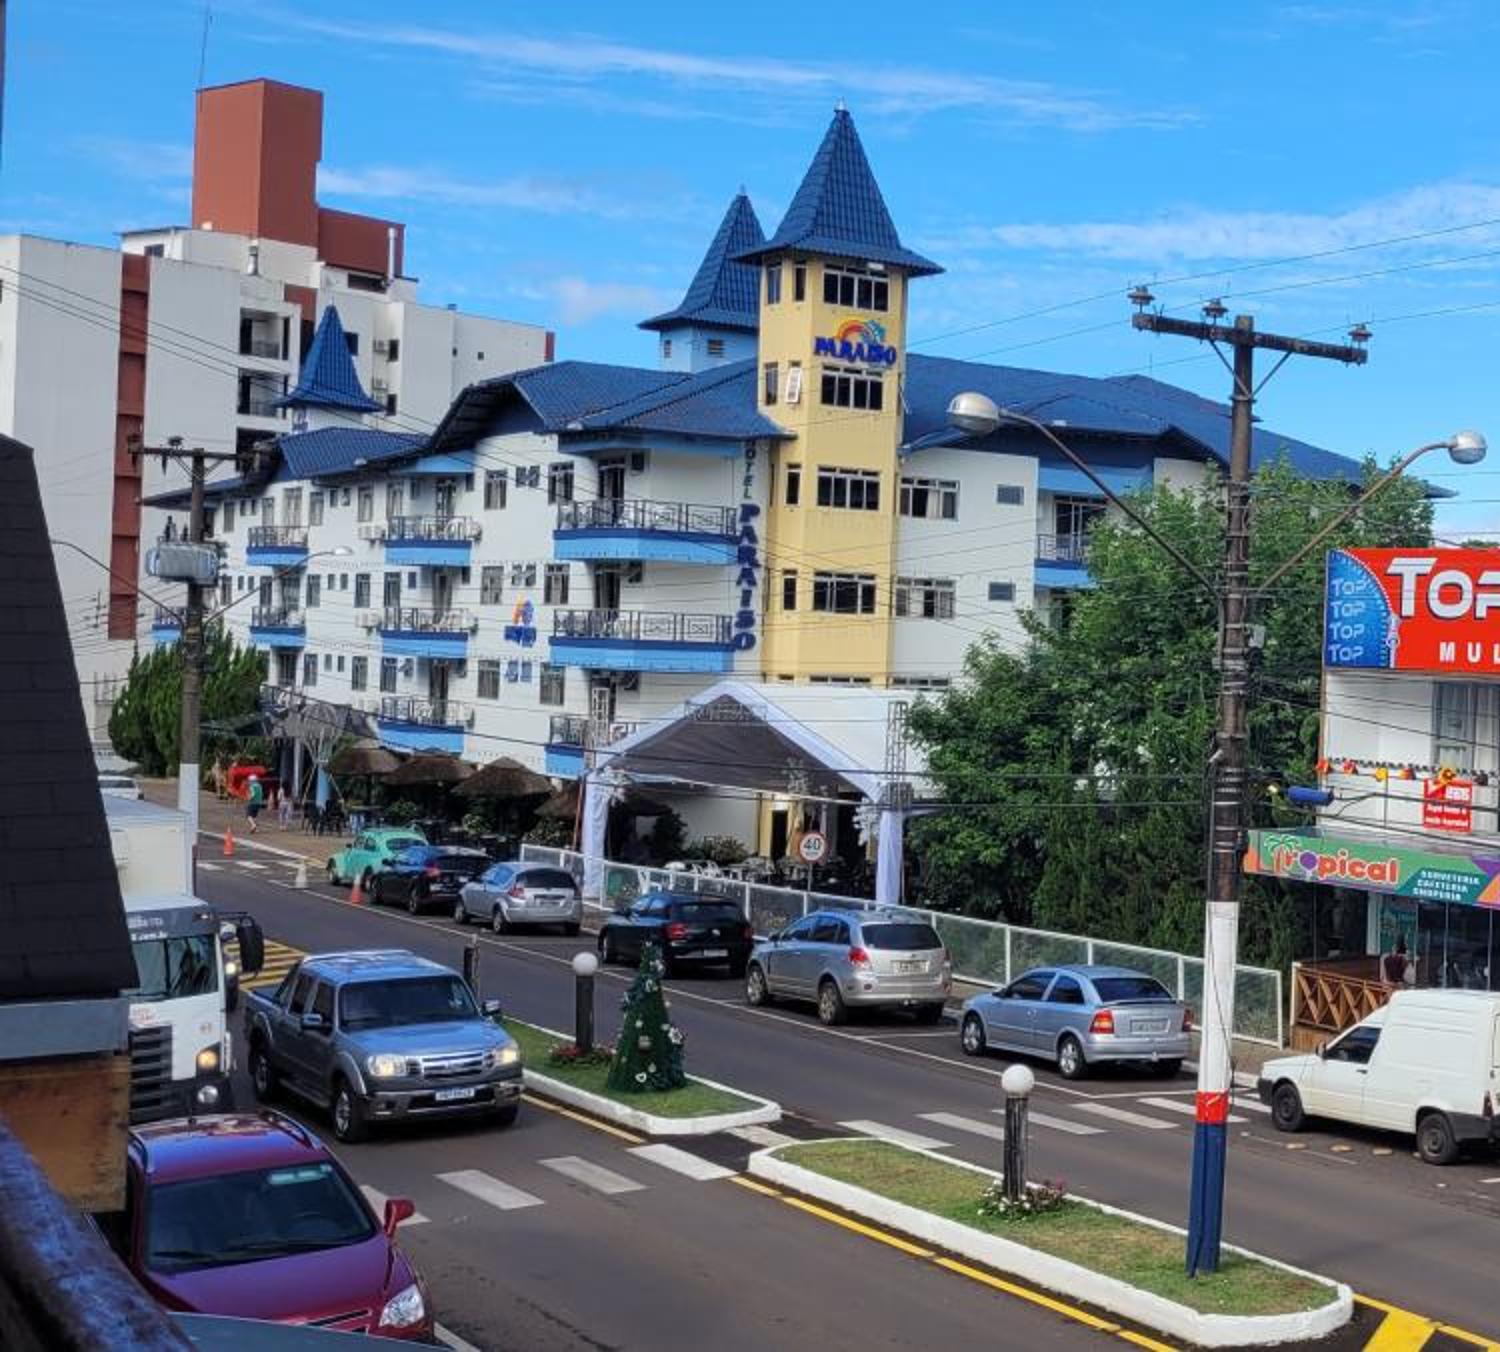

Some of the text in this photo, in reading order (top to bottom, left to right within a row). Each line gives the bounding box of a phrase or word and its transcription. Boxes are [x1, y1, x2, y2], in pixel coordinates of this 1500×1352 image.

[814, 336, 897, 366] PARAISO
[734, 504, 761, 650] PARAISO
[803, 838, 821, 849] 40
